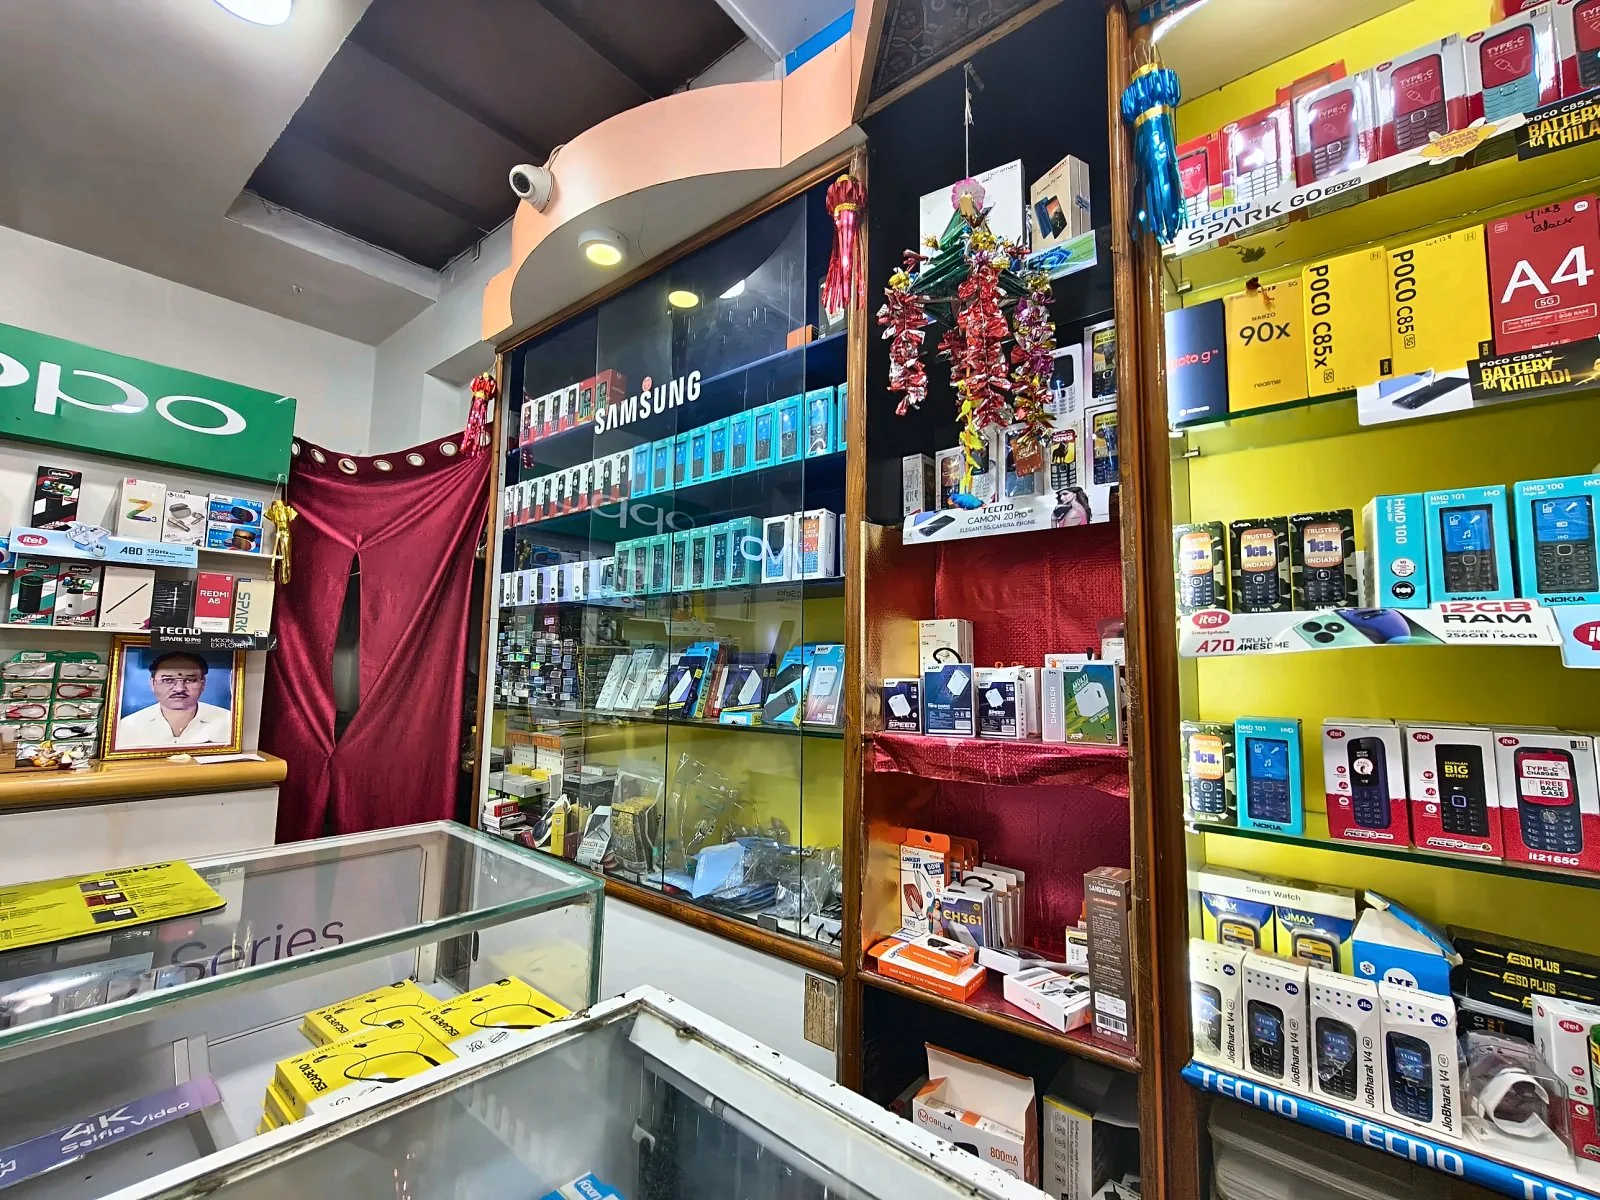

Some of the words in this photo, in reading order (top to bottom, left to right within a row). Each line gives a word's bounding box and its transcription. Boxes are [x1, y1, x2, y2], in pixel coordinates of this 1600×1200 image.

[1487, 36, 1525, 55] TYPE-C
[1400, 69, 1433, 86] TYPE-C
[1526, 109, 1558, 124] POCO
[1561, 100, 1593, 113] C85x
[1529, 135, 1544, 148] KA
[1188, 201, 1282, 247] SPARK
[1290, 189, 1322, 208] GO
[1326, 178, 1361, 195] 2024
[1392, 249, 1417, 303] POCO
[1501, 245, 1594, 304] A4
[1287, 280, 1298, 288] 5G
[1310, 264, 1331, 316] POCO
[1540, 298, 1555, 307] 5G
[1252, 312, 1277, 321] NARZO
[1396, 305, 1415, 335] C85
[1239, 321, 1291, 347] 90x
[1312, 321, 1333, 369] C85x
[1480, 358, 1510, 369] POCO
[1512, 352, 1543, 364] C85x
[1481, 358, 1554, 382] BATTERY
[1253, 379, 1282, 389] realme
[1482, 376, 1497, 390] KA
[1500, 368, 1571, 392] KHILADI
[594, 370, 701, 435] SAMSUNG
[1522, 485, 1544, 493] HMD
[1547, 482, 1564, 490] 100
[982, 503, 1014, 514] TECNO
[1394, 498, 1407, 528] HMD
[968, 515, 1001, 525] CAMON
[22, 536, 42, 545] itel
[1395, 529, 1407, 544] 100
[1244, 560, 1273, 568] INDIANS
[1307, 556, 1340, 564] INDIANS
[200, 590, 229, 598] REDMI
[235, 592, 251, 633] SPARK
[1439, 601, 1533, 613] 12GB
[1198, 613, 1223, 625] itel
[1442, 613, 1533, 624] RAM
[160, 626, 202, 636] TECNO
[210, 641, 249, 649] EXPLORER
[1196, 639, 1235, 653] A70
[1236, 641, 1290, 651] AWESOME
[1444, 765, 1468, 774] BIG
[1526, 765, 1558, 773] TYPE-C
[1252, 822, 1283, 831] NOKIA
[1528, 852, 1579, 865] it2165C
[1088, 885, 1121, 897] SANDALWOOD
[1245, 885, 1271, 896] Smart
[1274, 891, 1301, 901] Watch
[943, 910, 982, 926] CH361
[1285, 913, 1315, 925] JMAX
[170, 920, 346, 982] Series
[1224, 966, 1234, 974] Jio
[1534, 958, 1560, 975] PLUS
[1387, 976, 1413, 987] LYF
[1530, 978, 1556, 995] PLUS
[1286, 985, 1298, 993] Jio
[1359, 1001, 1371, 1009] Jio
[1227, 1011, 1234, 1023] V4
[1432, 1016, 1447, 1025] Jio
[1563, 1021, 1580, 1032] itel
[1226, 1024, 1235, 1063] JioBharat
[1291, 1032, 1299, 1044] V4
[1364, 1050, 1373, 1063] V4
[1291, 1045, 1301, 1086] JioBharat
[1440, 1069, 1449, 1081] V4
[1364, 1063, 1375, 1108] JioBharat
[1197, 1066, 1299, 1119] TECNO
[1440, 1083, 1452, 1131] JioBharat
[60, 1106, 133, 1142] 4K
[61, 1125, 126, 1154] Selfie
[130, 1101, 190, 1126] Video
[1338, 1116, 1465, 1176] TECNO
